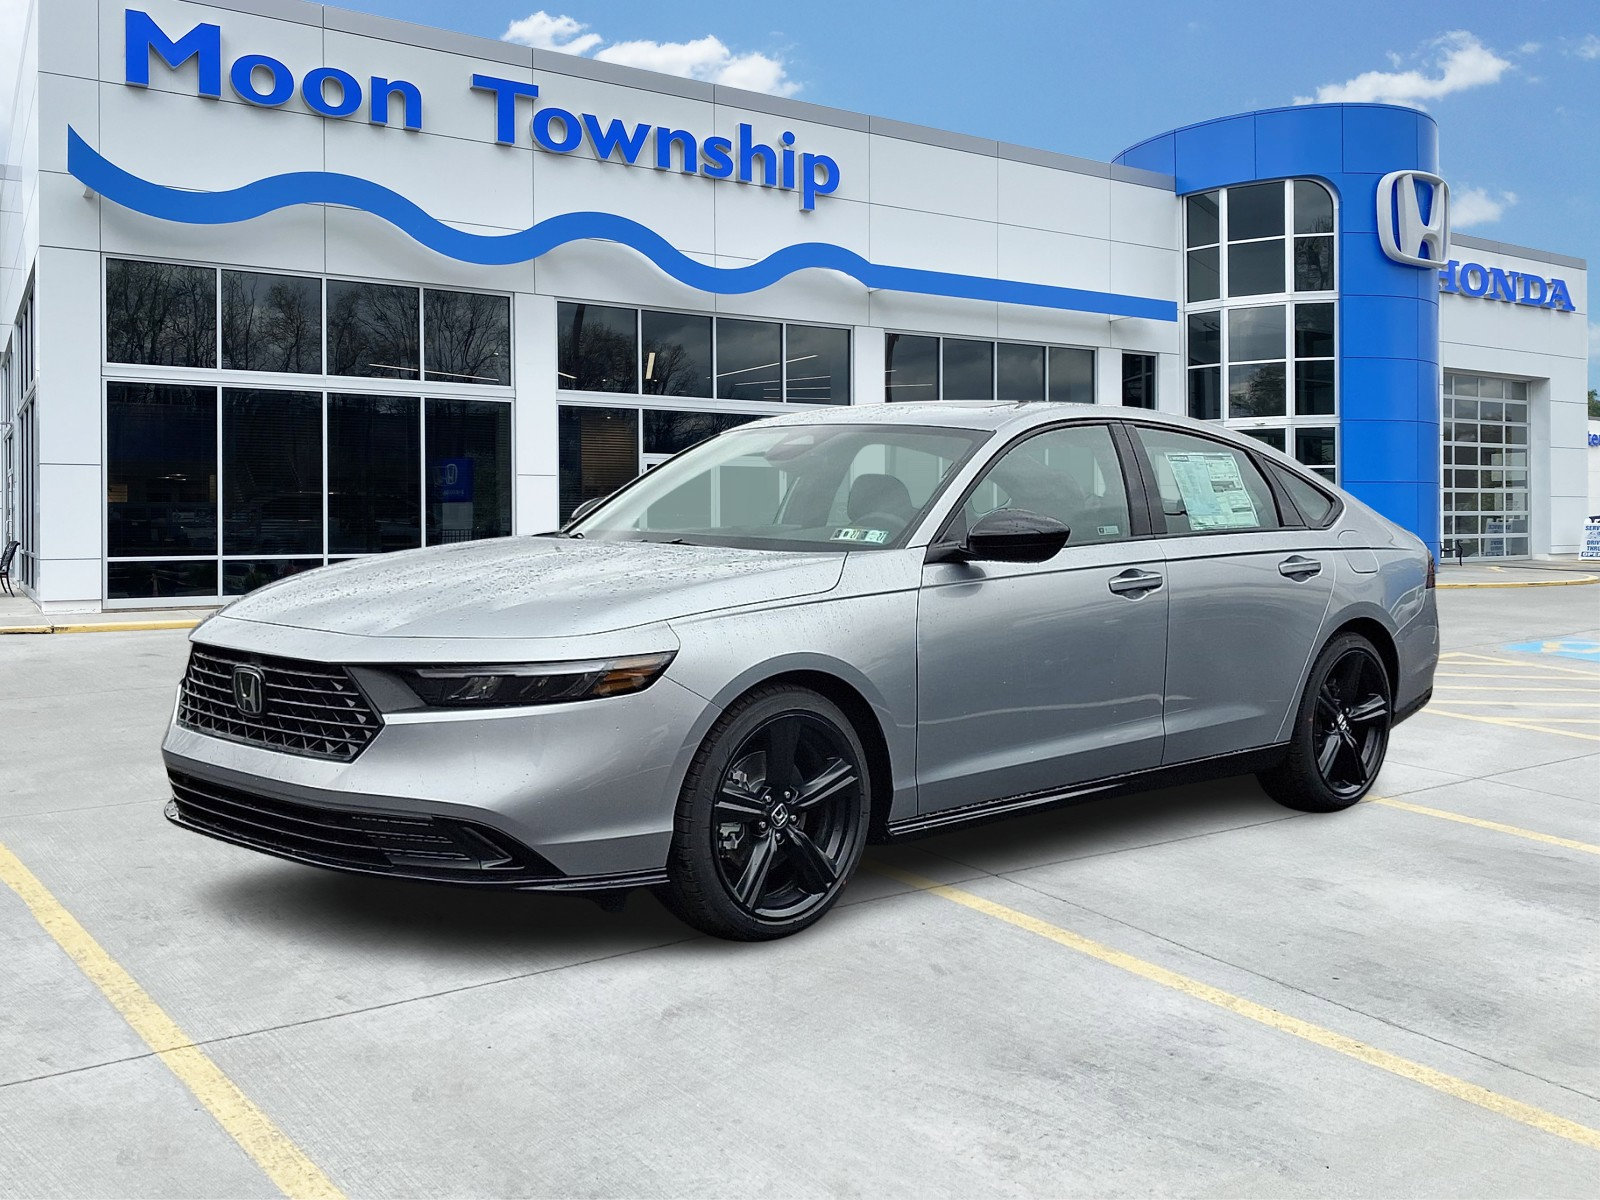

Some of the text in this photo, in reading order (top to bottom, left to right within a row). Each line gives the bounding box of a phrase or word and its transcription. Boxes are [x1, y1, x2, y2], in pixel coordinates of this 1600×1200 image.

[125, 9, 841, 212] Moon Township
[1439, 260, 1576, 312] HONDA
